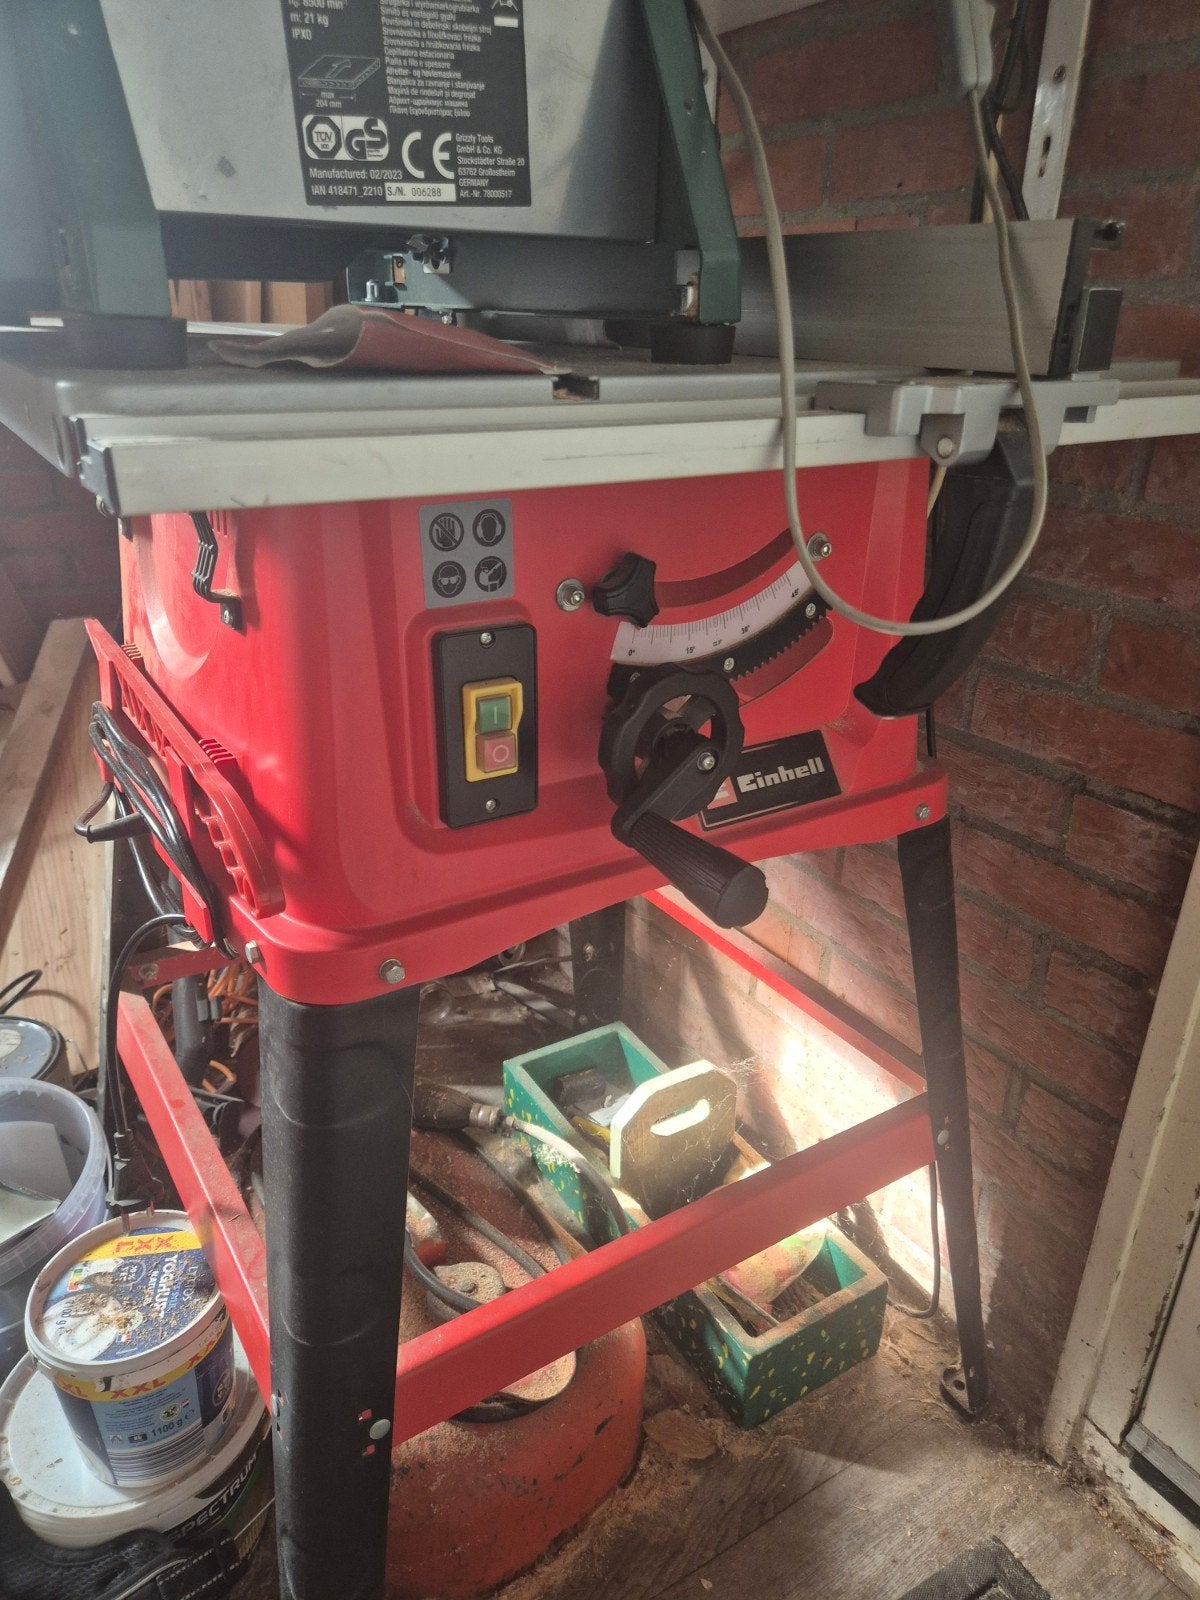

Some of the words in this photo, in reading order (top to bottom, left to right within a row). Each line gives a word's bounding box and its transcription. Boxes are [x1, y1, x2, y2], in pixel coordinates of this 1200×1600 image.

[304, 12, 315, 25] 21
[317, 12, 329, 28] kg
[455, 133, 476, 144] Grizzly
[477, 134, 494, 143] Tools
[456, 145, 475, 154] GmbH
[476, 146, 482, 154] &
[482, 146, 492, 154] Co.
[494, 146, 503, 155] KG
[457, 156, 495, 166] Stockstädter
[496, 157, 516, 166] Straße
[517, 158, 525, 166] 20
[309, 168, 368, 179] Manufactured:
[370, 169, 403, 180] 02/2023
[458, 167, 477, 176] 63762
[478, 167, 516, 177] Großostheim
[458, 178, 489, 187] GERMANY
[312, 185, 326, 196] IAN
[328, 185, 383, 198] 418471_2210
[387, 186, 407, 197] S./N.
[411, 187, 442, 197] 006288
[459, 189, 482, 198] Art.-Nr.
[736, 756, 825, 793] Einhell
[111, 1379, 167, 1400] XXL
[151, 1422, 175, 1437] 1100
[176, 1419, 184, 1428] g
